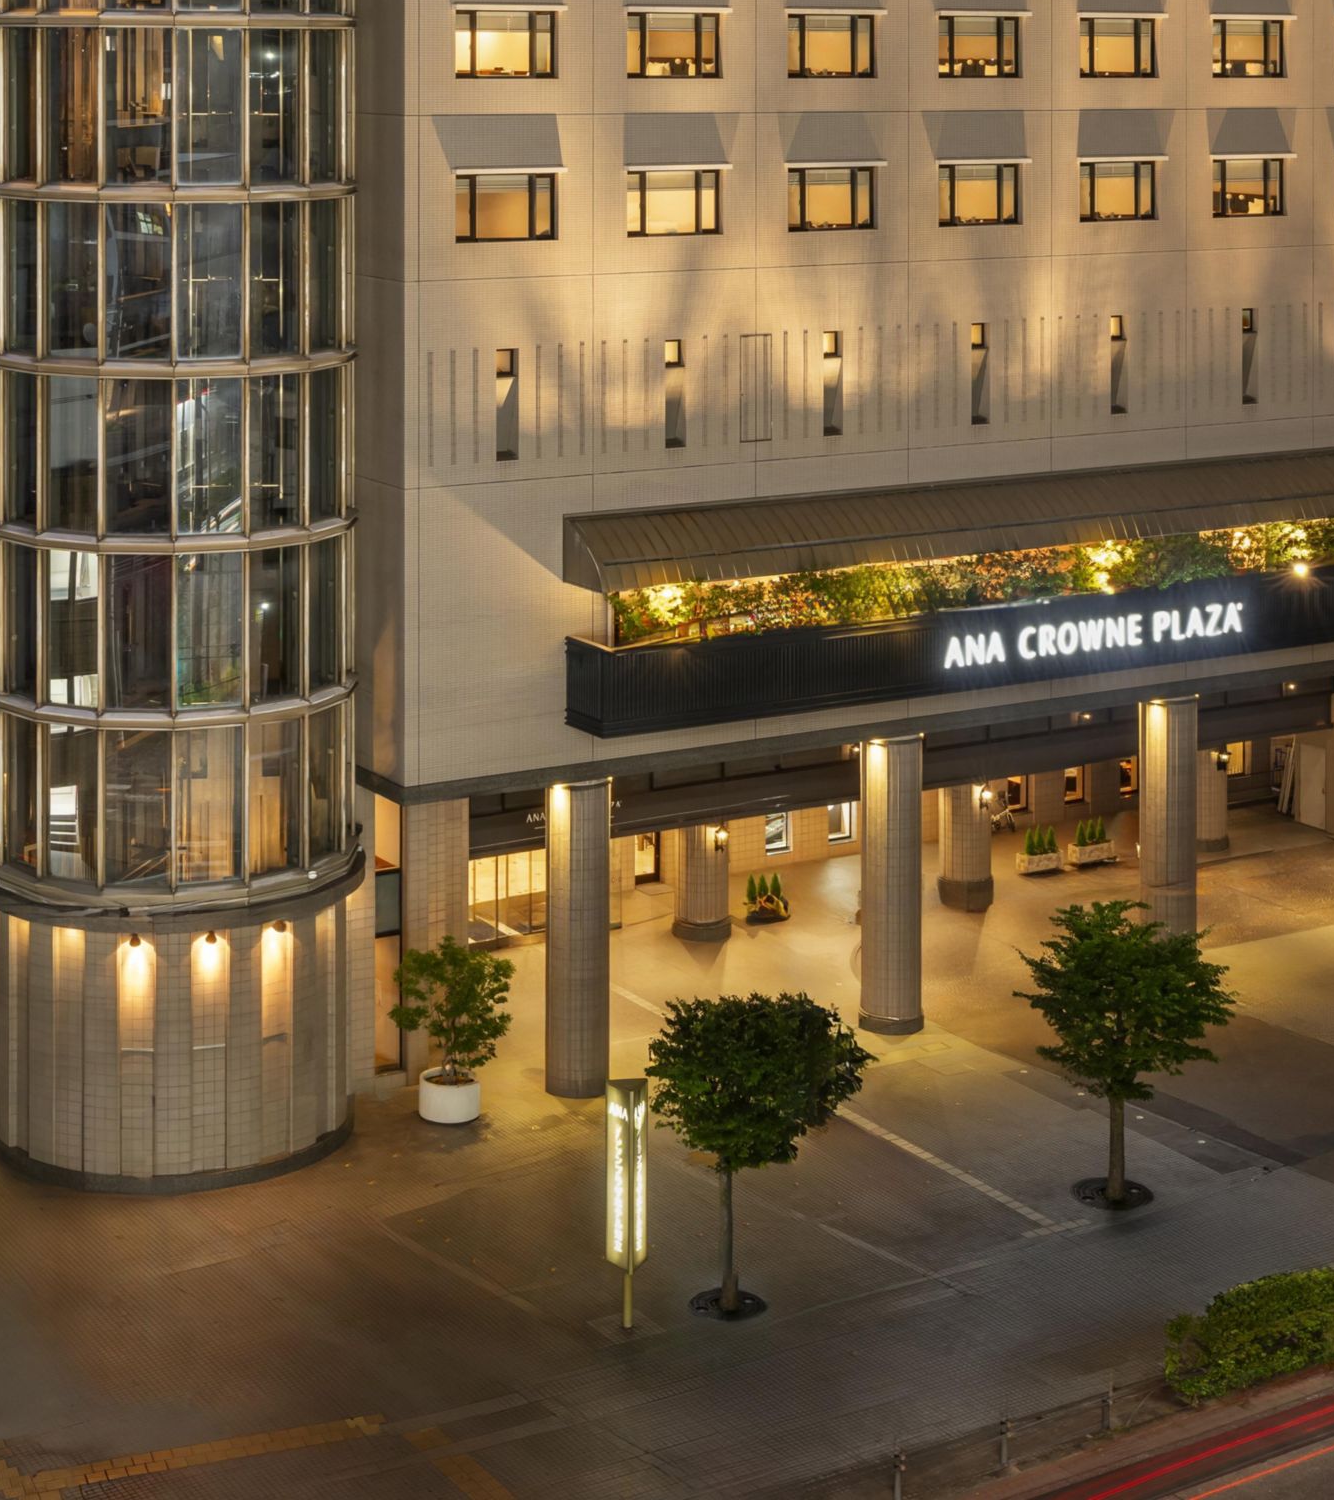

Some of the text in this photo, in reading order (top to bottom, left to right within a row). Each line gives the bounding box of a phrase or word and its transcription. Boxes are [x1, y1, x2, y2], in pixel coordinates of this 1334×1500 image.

[944, 603, 1242, 669] ANA CROWNE PLAZA
